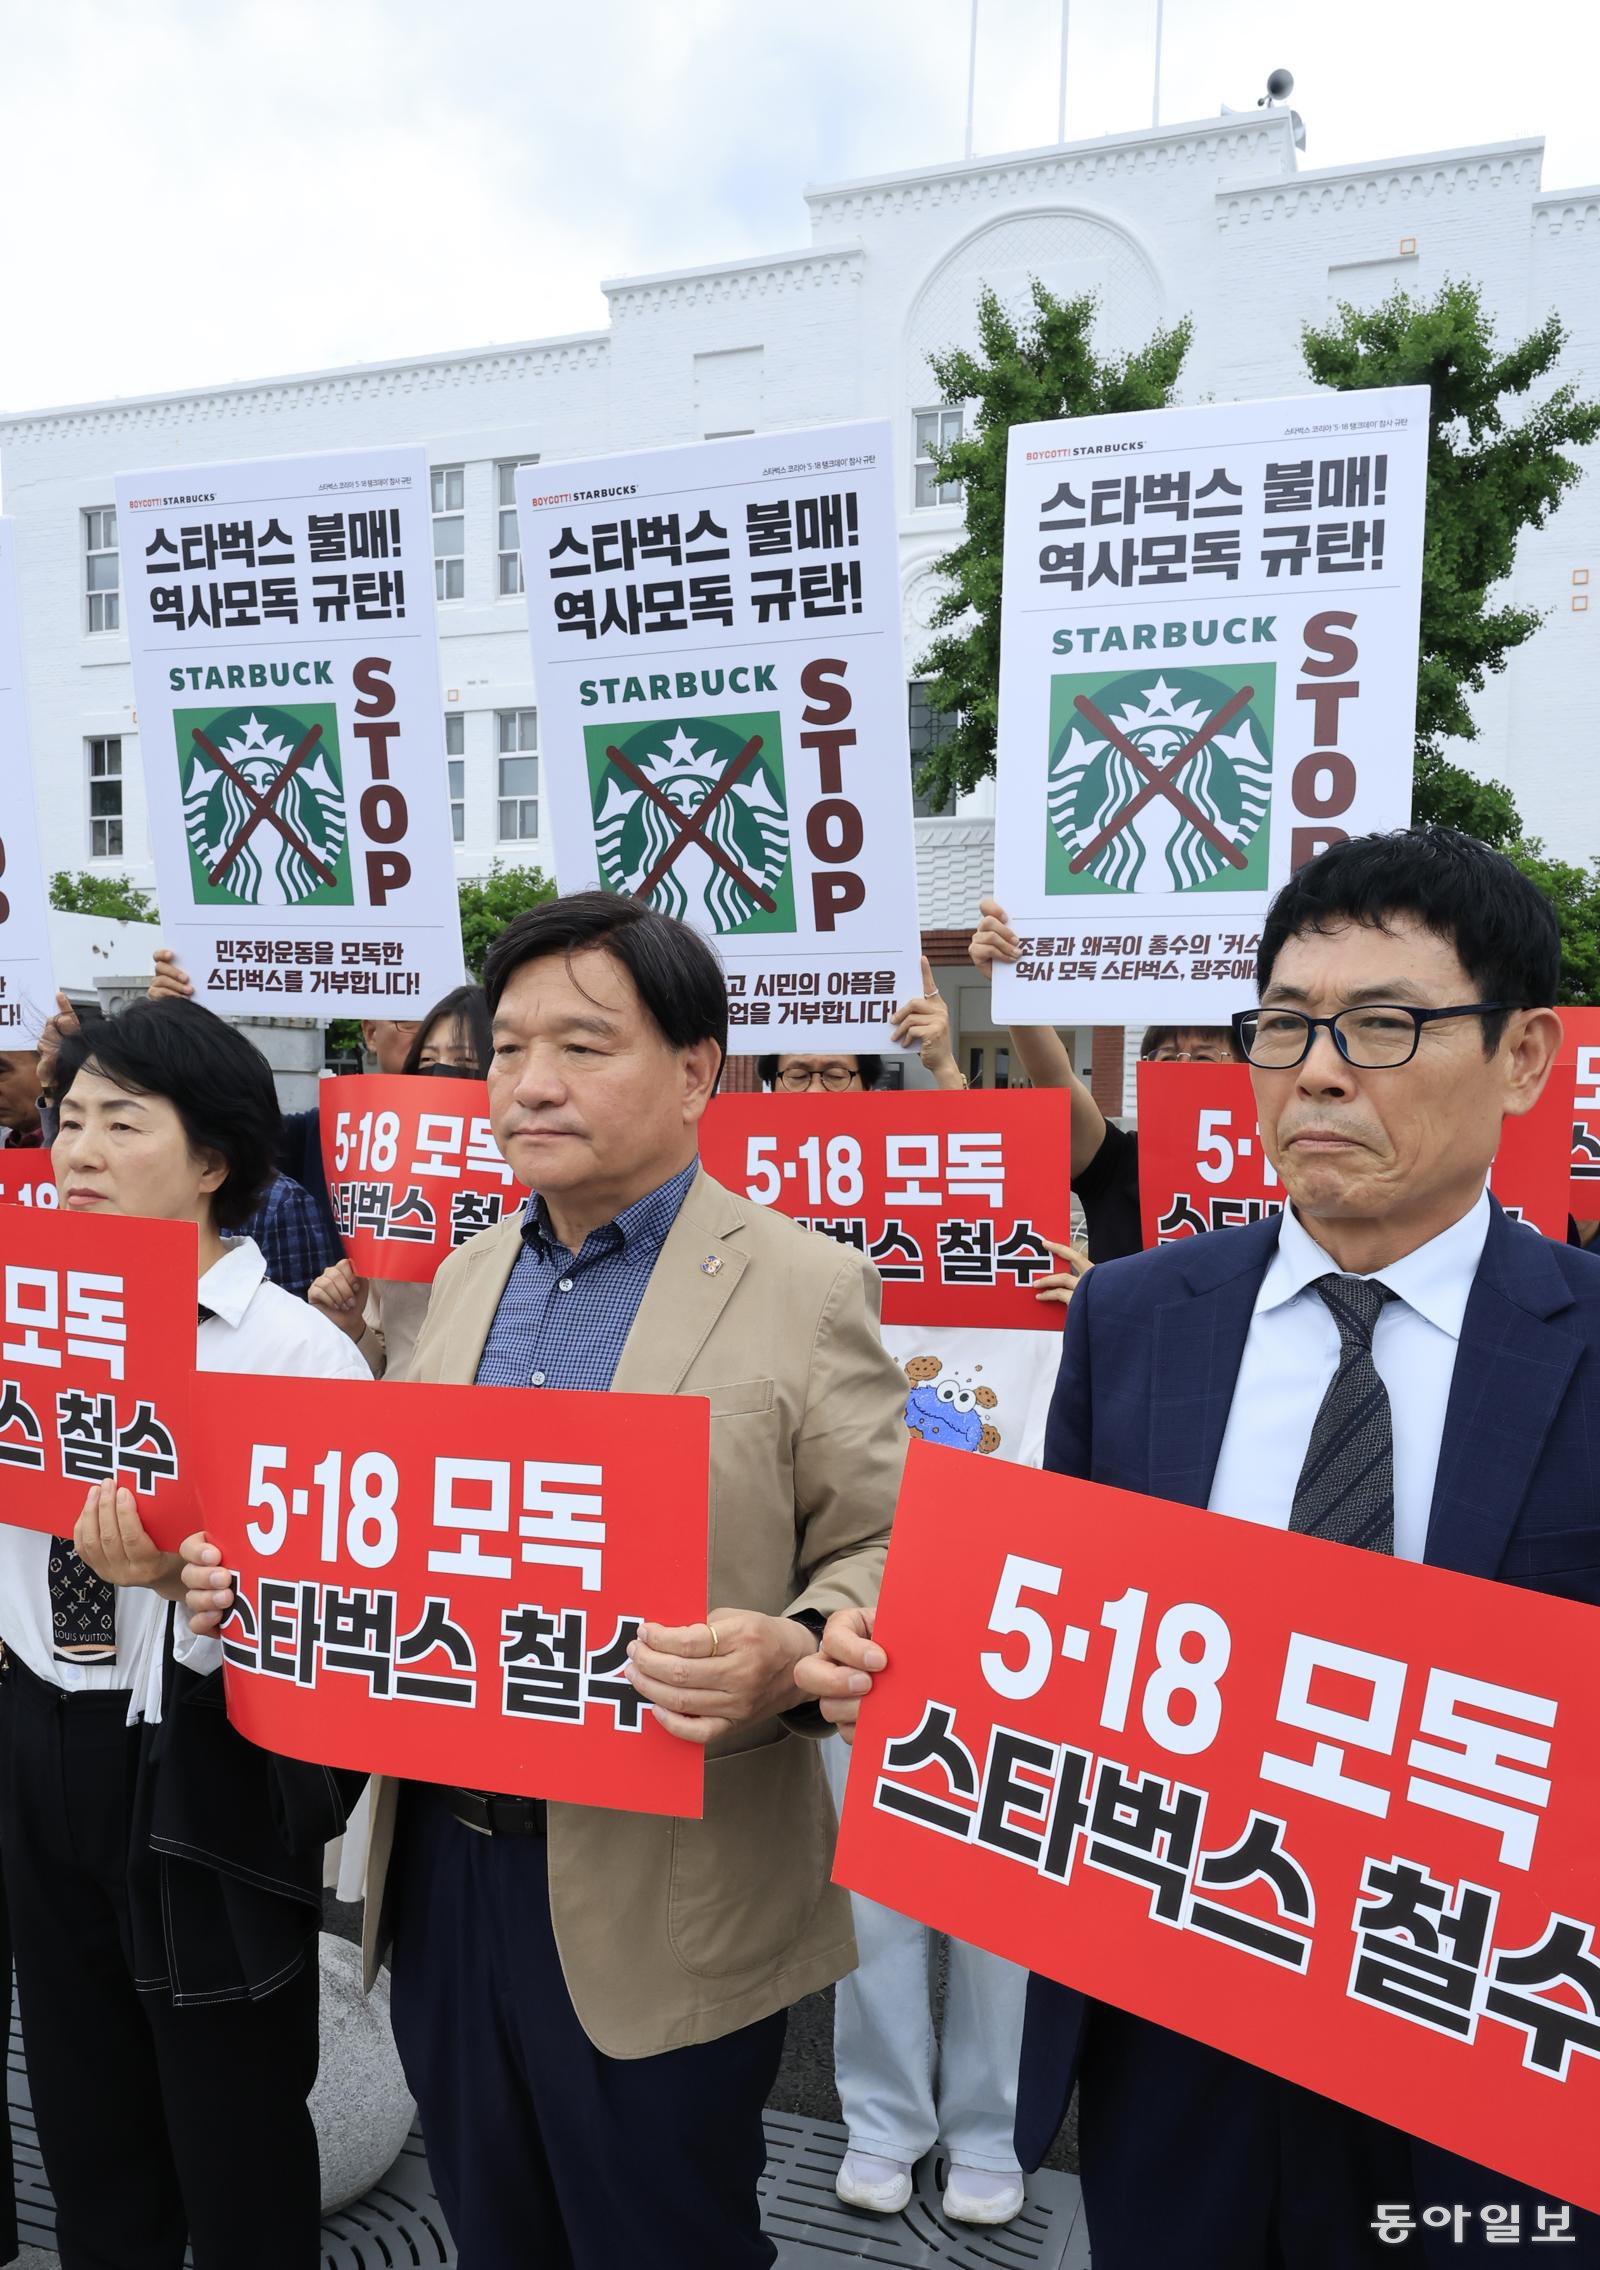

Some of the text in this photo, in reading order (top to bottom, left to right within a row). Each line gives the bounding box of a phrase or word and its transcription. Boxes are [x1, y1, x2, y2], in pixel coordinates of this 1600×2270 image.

[1026, 441, 1144, 460] BOYCOTT! STARBUCKS
[1311, 424, 1332, 433] 코리아
[1394, 418, 1408, 426] 규탄
[788, 463, 806, 473] 코리아
[863, 454, 876, 464] 규탄
[1038, 454, 1388, 532] 스타벅스 불매!
[163, 492, 216, 506] STARBUCKS
[532, 485, 638, 507] BOYCOTT! STARBUCKS
[145, 508, 402, 574] 스타벅스 불매!
[549, 491, 860, 579] 스타벅스 불매!
[1038, 519, 1385, 592] 역사모독 규탄!
[150, 570, 406, 630] 역사모독 규탄!
[554, 561, 863, 641] 역사모독 규탄!
[1052, 615, 1278, 656] STARBUCK
[169, 660, 334, 692] STARBUCK
[579, 664, 778, 707] STARBUCK
[352, 656, 412, 907] STOP
[800, 658, 866, 932] STOP
[216, 940, 404, 966] 민주화운동을 모독한
[1016, 959, 1258, 982] 역사 모독 스타벅스, 광주에
[1018, 937, 1076, 957] 조롱과
[1080, 936, 1143, 957] 왜곡이
[1148, 934, 1212, 956] 총수의
[207, 968, 420, 996] 스타벅스를 거부합니다!
[727, 1000, 897, 1025] 업을 거부합니다!
[754, 973, 820, 997] 시민의
[827, 970, 896, 995] 아픔을
[335, 1111, 514, 1186] 5·18 모독
[745, 1132, 1006, 1208] 5·18 모독
[936, 1218, 1054, 1287] 철수
[3, 1265, 127, 1381] 모독
[55, 1388, 178, 1496] 철수
[246, 1443, 606, 1592] 5·18 모독
[54, 1629, 112, 1642] LOUIS VUITTON
[499, 1604, 657, 1733] 철수
[979, 1553, 1559, 1872] 5·18 모독
[872, 1698, 1600, 2084] 스타벅스 철수
